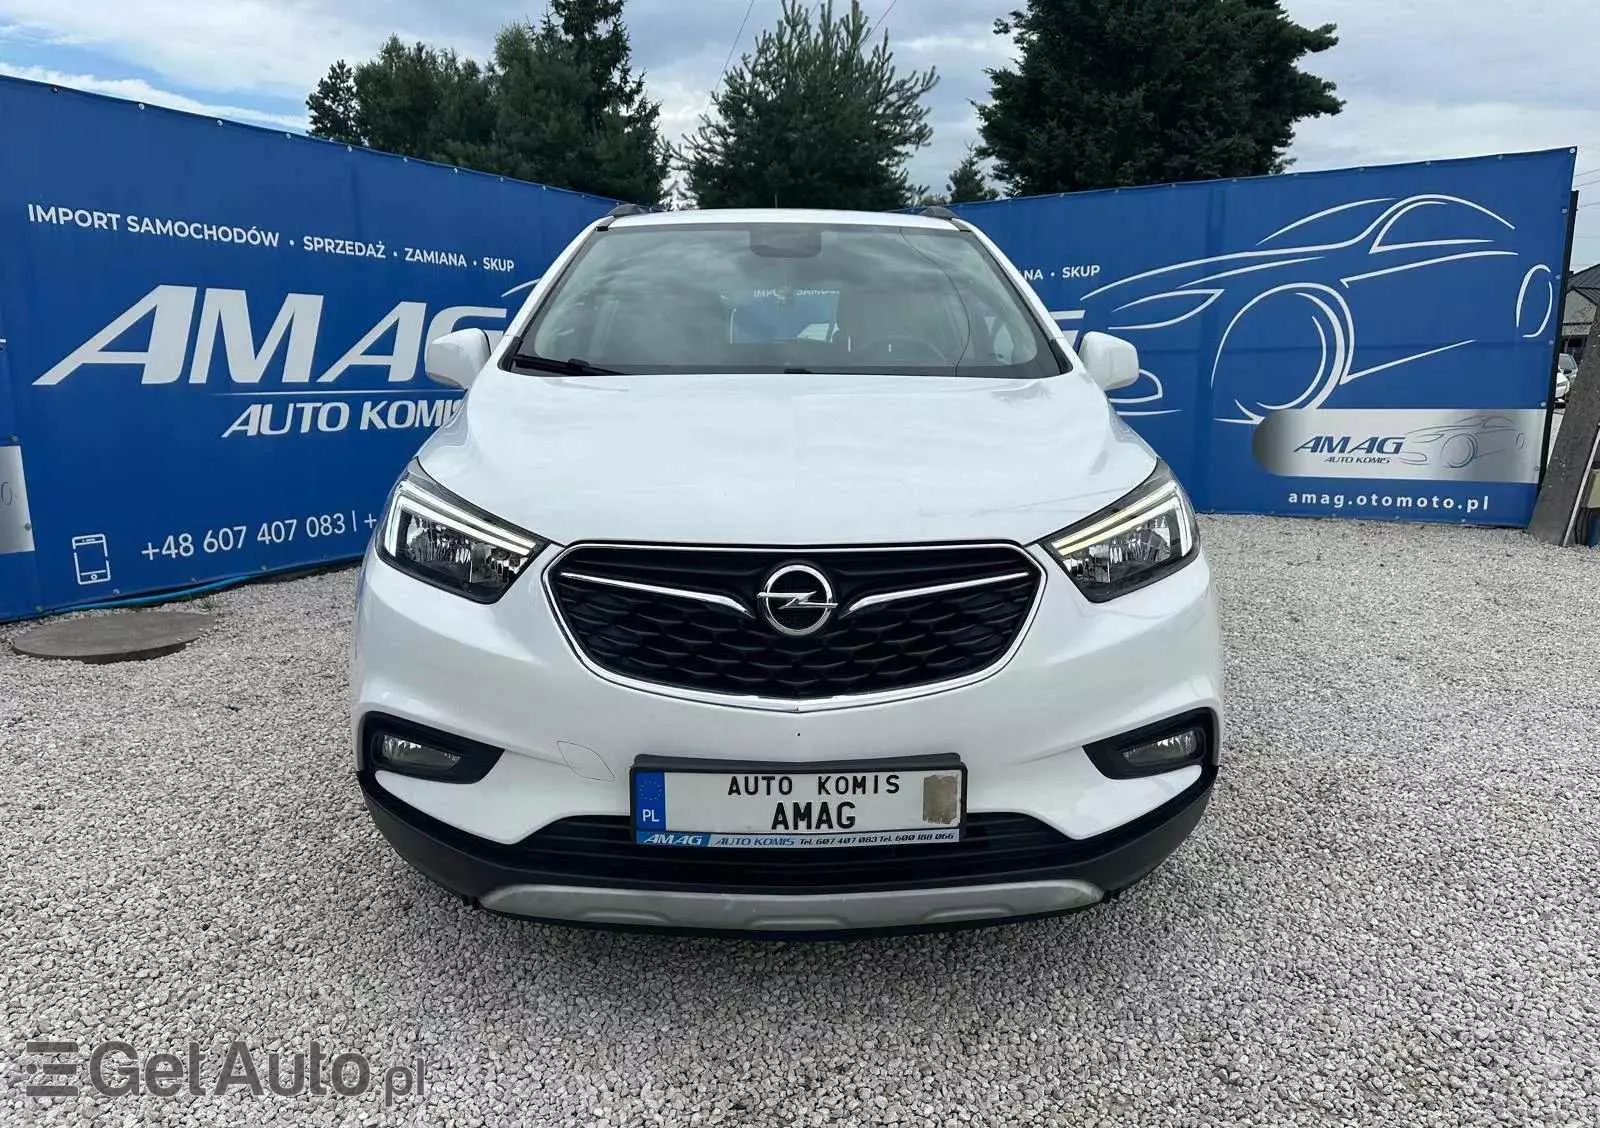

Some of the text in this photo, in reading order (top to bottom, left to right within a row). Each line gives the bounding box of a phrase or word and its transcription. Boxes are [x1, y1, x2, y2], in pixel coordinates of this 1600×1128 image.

[27, 203, 515, 273] IMPORT SAMOCHODÓW SPRZEDAŻ ZAMIANA SKUP
[1062, 264, 1101, 279] SKUP
[221, 402, 350, 438] AUTO
[1326, 456, 1391, 464] AUTO KOMIS
[1288, 491, 1489, 513] amag.otomoto.pl
[141, 532, 195, 561] +48
[203, 525, 248, 553] 607
[257, 518, 298, 545] 407
[306, 512, 346, 538] 083
[728, 774, 901, 796] AUTO KOMIS
[642, 809, 659, 822] PL
[771, 801, 856, 831] AMAG
[715, 837, 751, 846] AUTO
[754, 837, 796, 846] KOMIS
